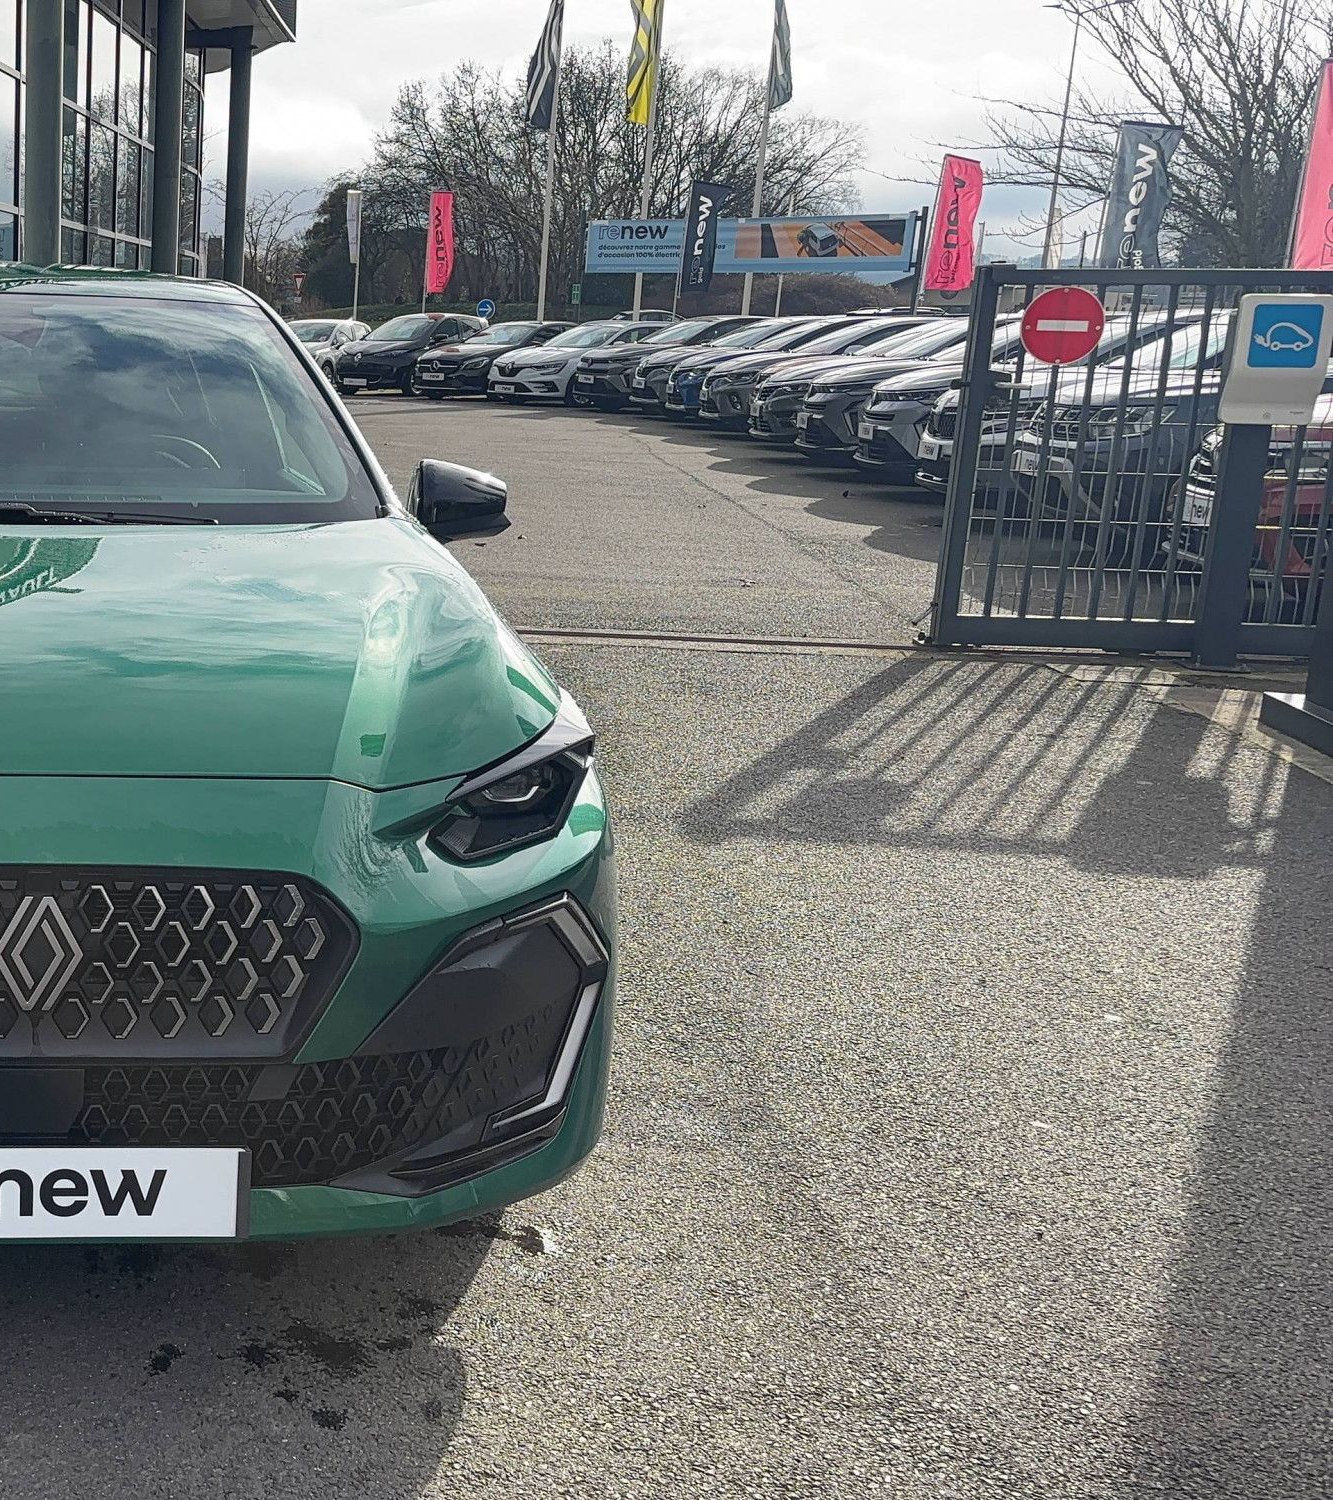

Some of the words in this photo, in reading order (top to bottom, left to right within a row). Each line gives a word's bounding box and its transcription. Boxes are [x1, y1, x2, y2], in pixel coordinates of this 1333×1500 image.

[434, 206, 445, 288] renew
[598, 224, 669, 240] renew
[598, 243, 634, 251] découvrez
[689, 195, 713, 285] renew
